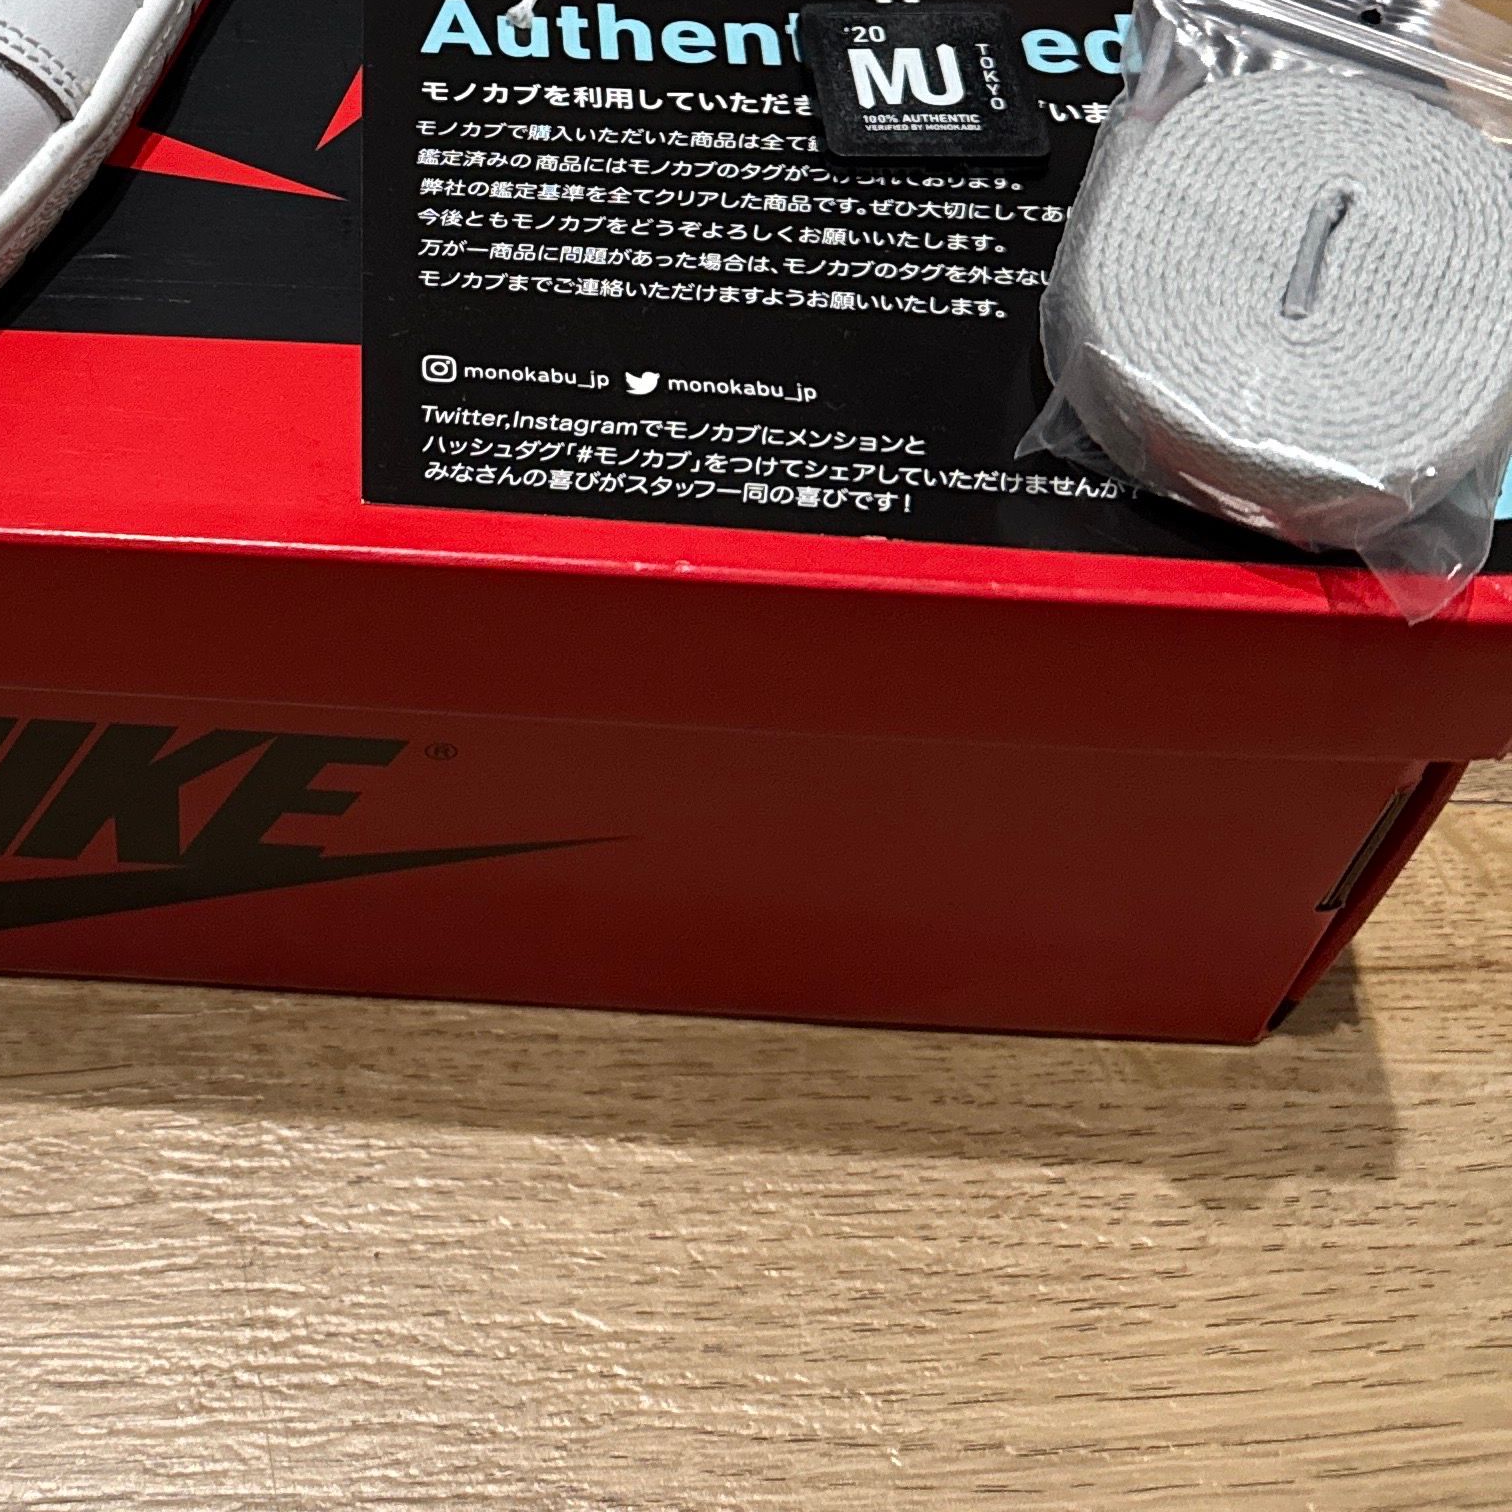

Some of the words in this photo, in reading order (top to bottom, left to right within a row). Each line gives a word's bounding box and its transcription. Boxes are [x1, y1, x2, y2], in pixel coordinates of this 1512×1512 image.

[974, 43, 1007, 111] TOKYO
[862, 114, 899, 124] 100%
[901, 114, 981, 124] AUTHENTIC
[417, 207, 1006, 254] 今後ともモノカブをどうぞよろしくお願いいたします。
[418, 269, 1008, 319] モノカブまでご連絡いただけますようお願いいたします。
[464, 364, 610, 389] monokabu_jp
[668, 376, 818, 402] monokabu_jp
